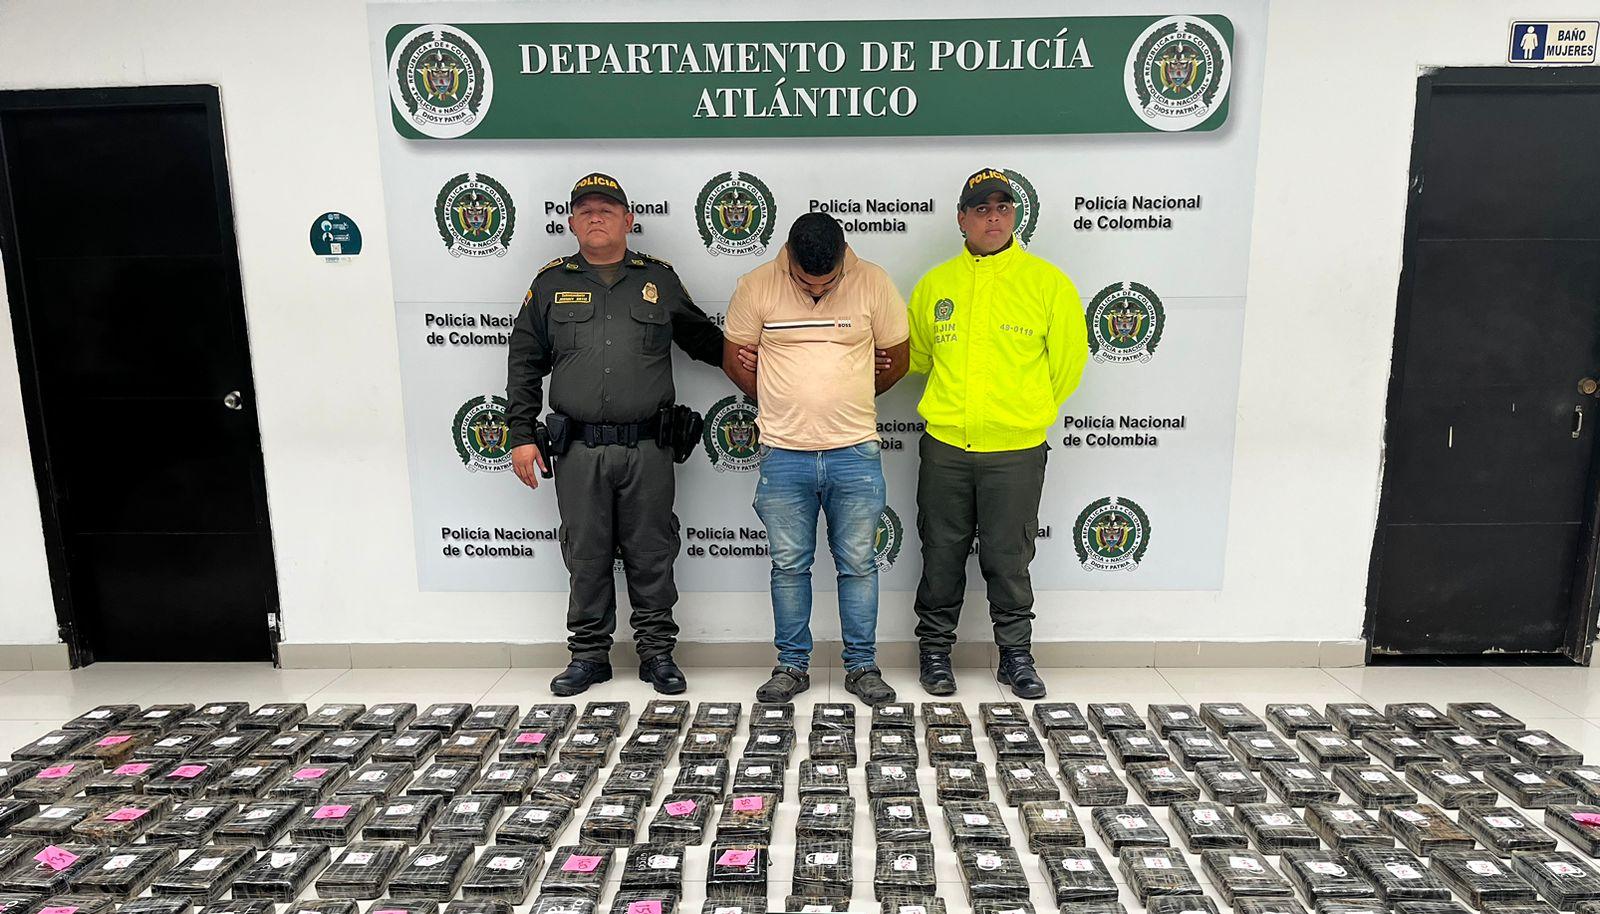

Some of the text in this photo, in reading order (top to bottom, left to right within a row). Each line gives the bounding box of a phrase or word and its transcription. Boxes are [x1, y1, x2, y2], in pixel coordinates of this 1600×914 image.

[1558, 28, 1586, 41] BAÑO
[519, 27, 1094, 74] DEPARTAMENTO DE POLICÍA
[1145, 37, 1169, 76] REPUBLICA
[1193, 38, 1212, 74] COLOMBIA
[1546, 45, 1594, 56] MUJERES
[409, 46, 428, 83] REPUBLICA
[450, 46, 474, 83] COLOMBIA
[693, 77, 918, 118] ATLÁNTICO
[1148, 84, 1208, 106] POLICIA NACIONAL
[414, 92, 472, 114] POLICIA NACIONAL
[1176, 104, 1199, 115] PATRIA
[444, 112, 466, 122] PATRIA
[575, 176, 618, 190] POLICIA
[630, 201, 668, 214] ional
[809, 199, 933, 212] Policía Nacional
[1074, 195, 1200, 210] Policía Nacional
[546, 221, 564, 233] de
[1074, 215, 1172, 229] de Colombia
[450, 228, 470, 246] POLICIA
[709, 226, 730, 245] POLICIA
[425, 313, 519, 326] Policía Naci
[426, 332, 510, 344] de Colombi
[1096, 334, 1116, 352] POLICIA
[876, 420, 926, 432] aciona
[1064, 415, 1184, 428] Policía Nacional
[1063, 434, 1157, 446] de Colombia
[494, 452, 512, 464] NACIO
[742, 452, 760, 464] NACIO
[442, 527, 556, 540] Policía Nacional
[686, 527, 734, 540] Policía
[881, 514, 894, 540] OLOMBIA
[442, 544, 533, 556] de Colombia
[688, 544, 768, 556] de Colombi
